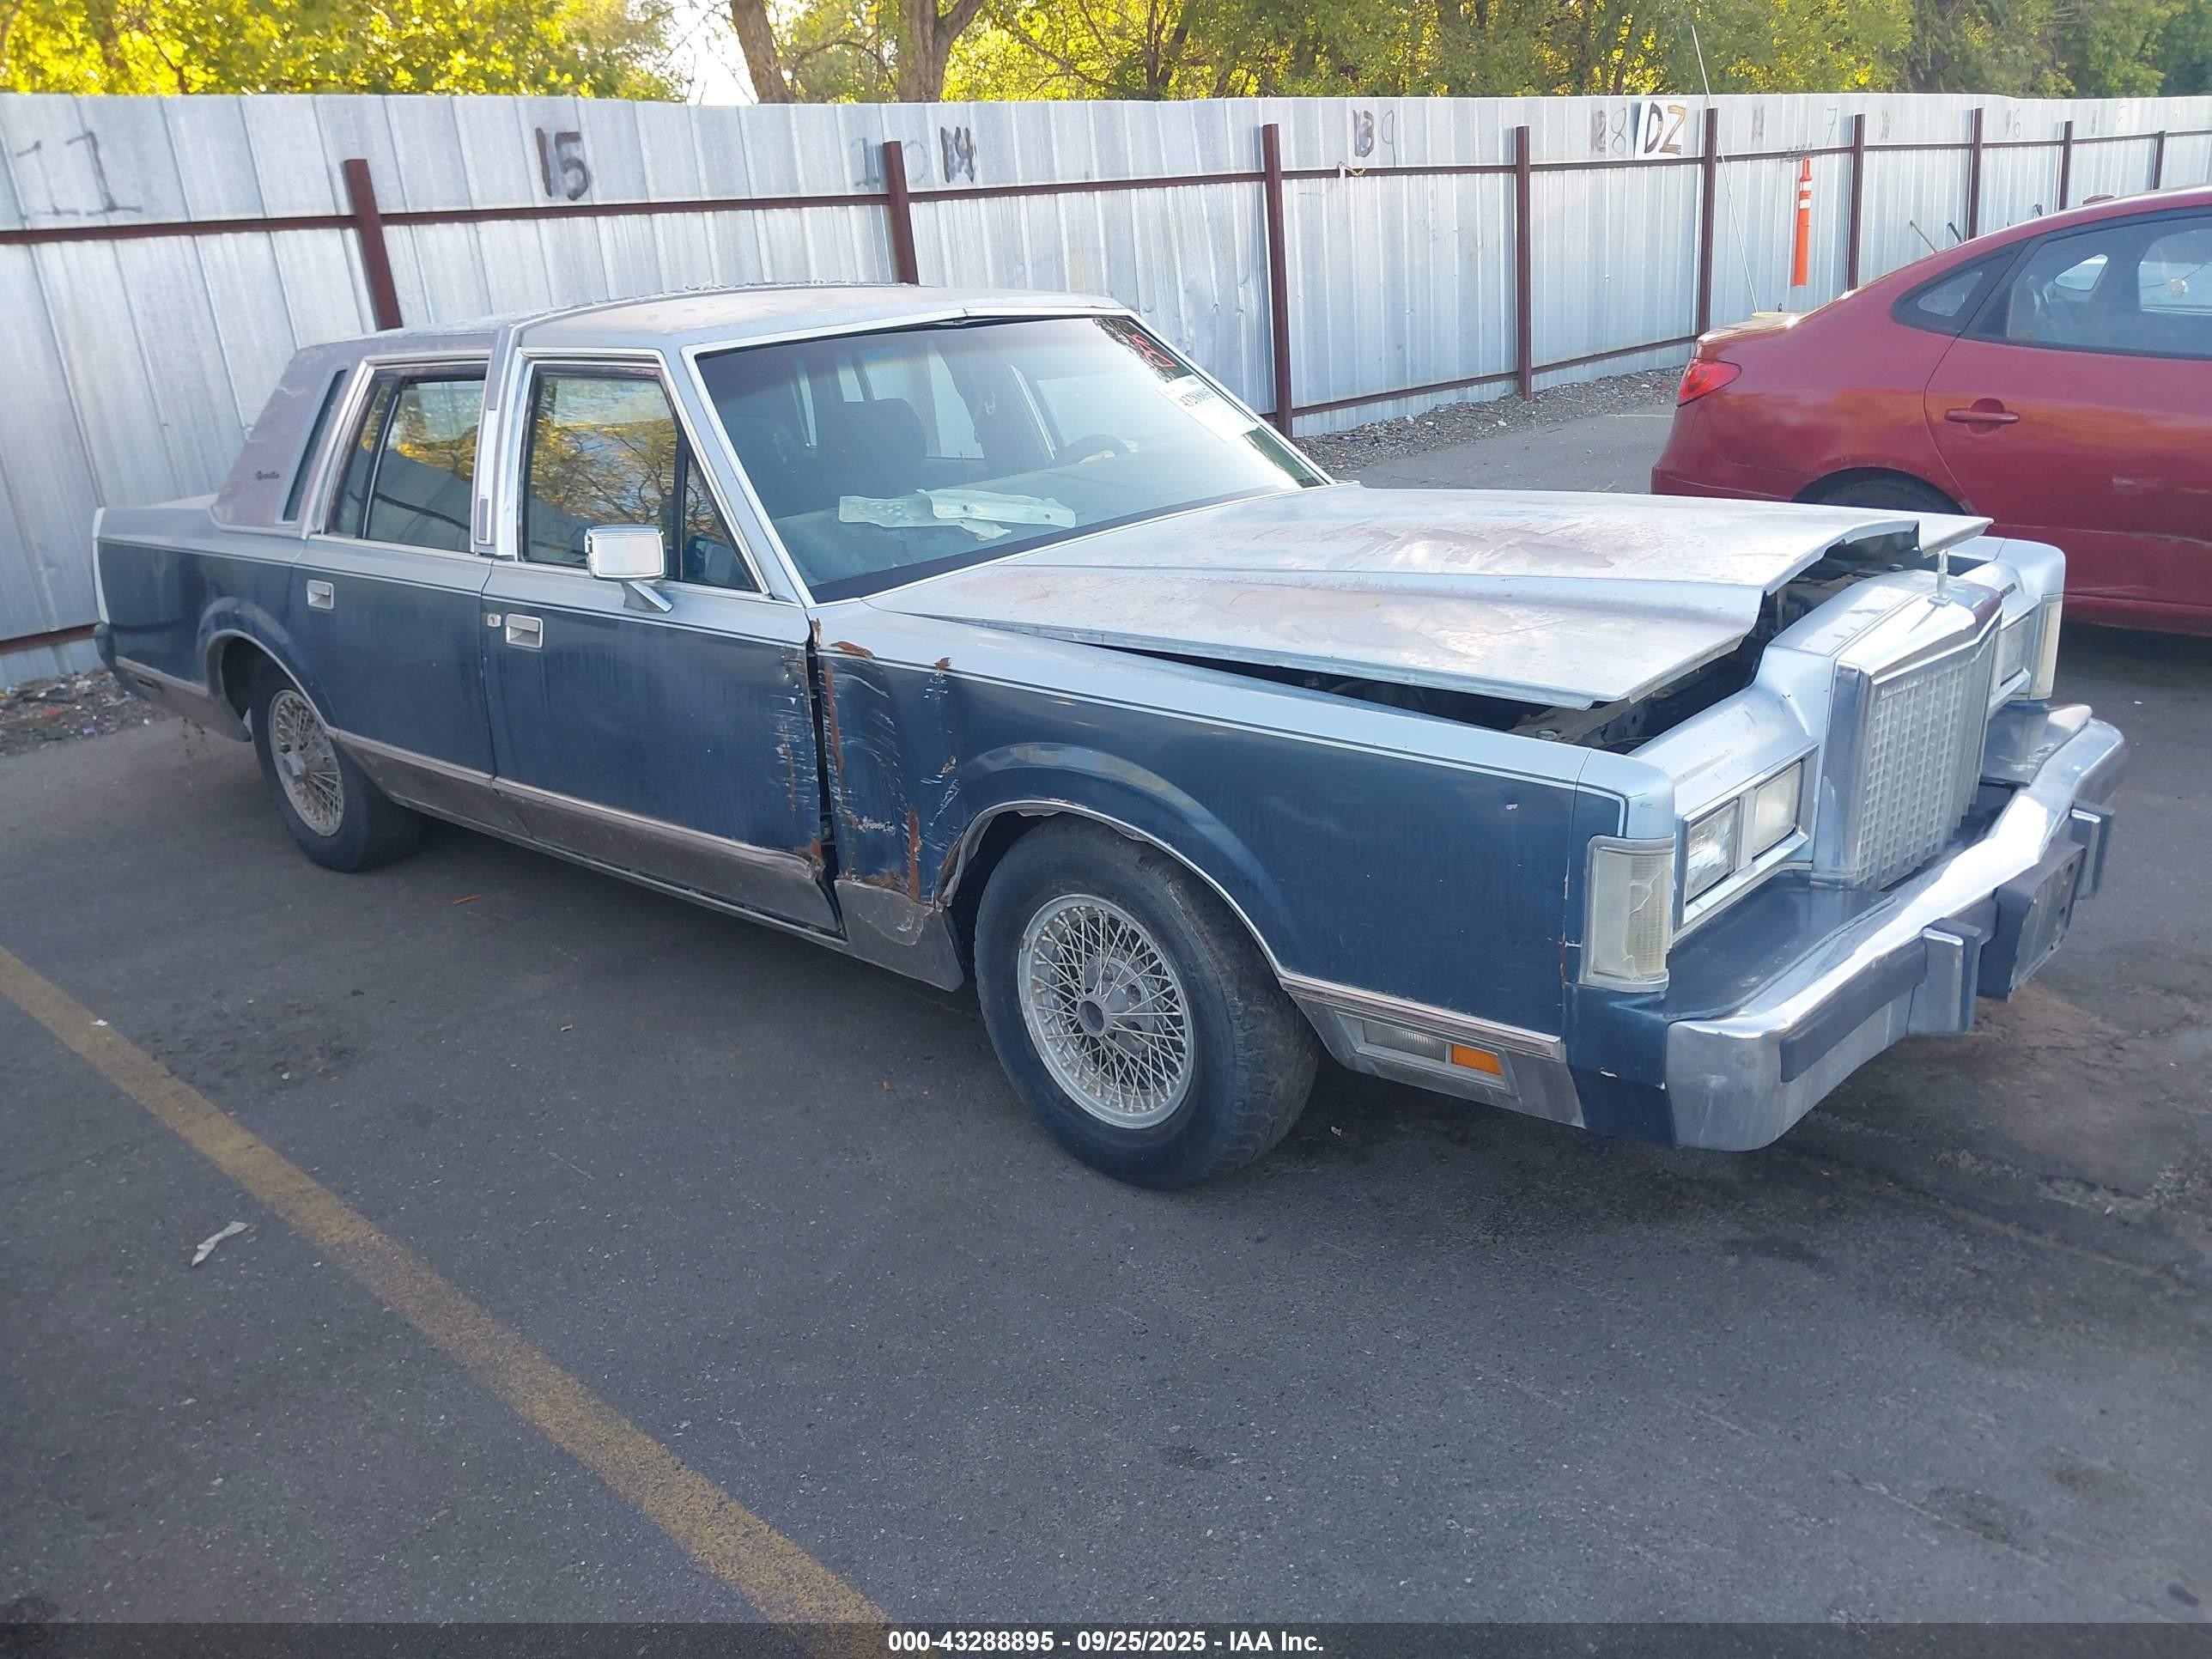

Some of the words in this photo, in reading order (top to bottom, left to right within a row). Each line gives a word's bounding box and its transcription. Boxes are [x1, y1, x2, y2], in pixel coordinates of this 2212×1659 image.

[1611, 106, 1627, 155] 8
[1644, 101, 1686, 155] DZ
[534, 126, 591, 202] 15
